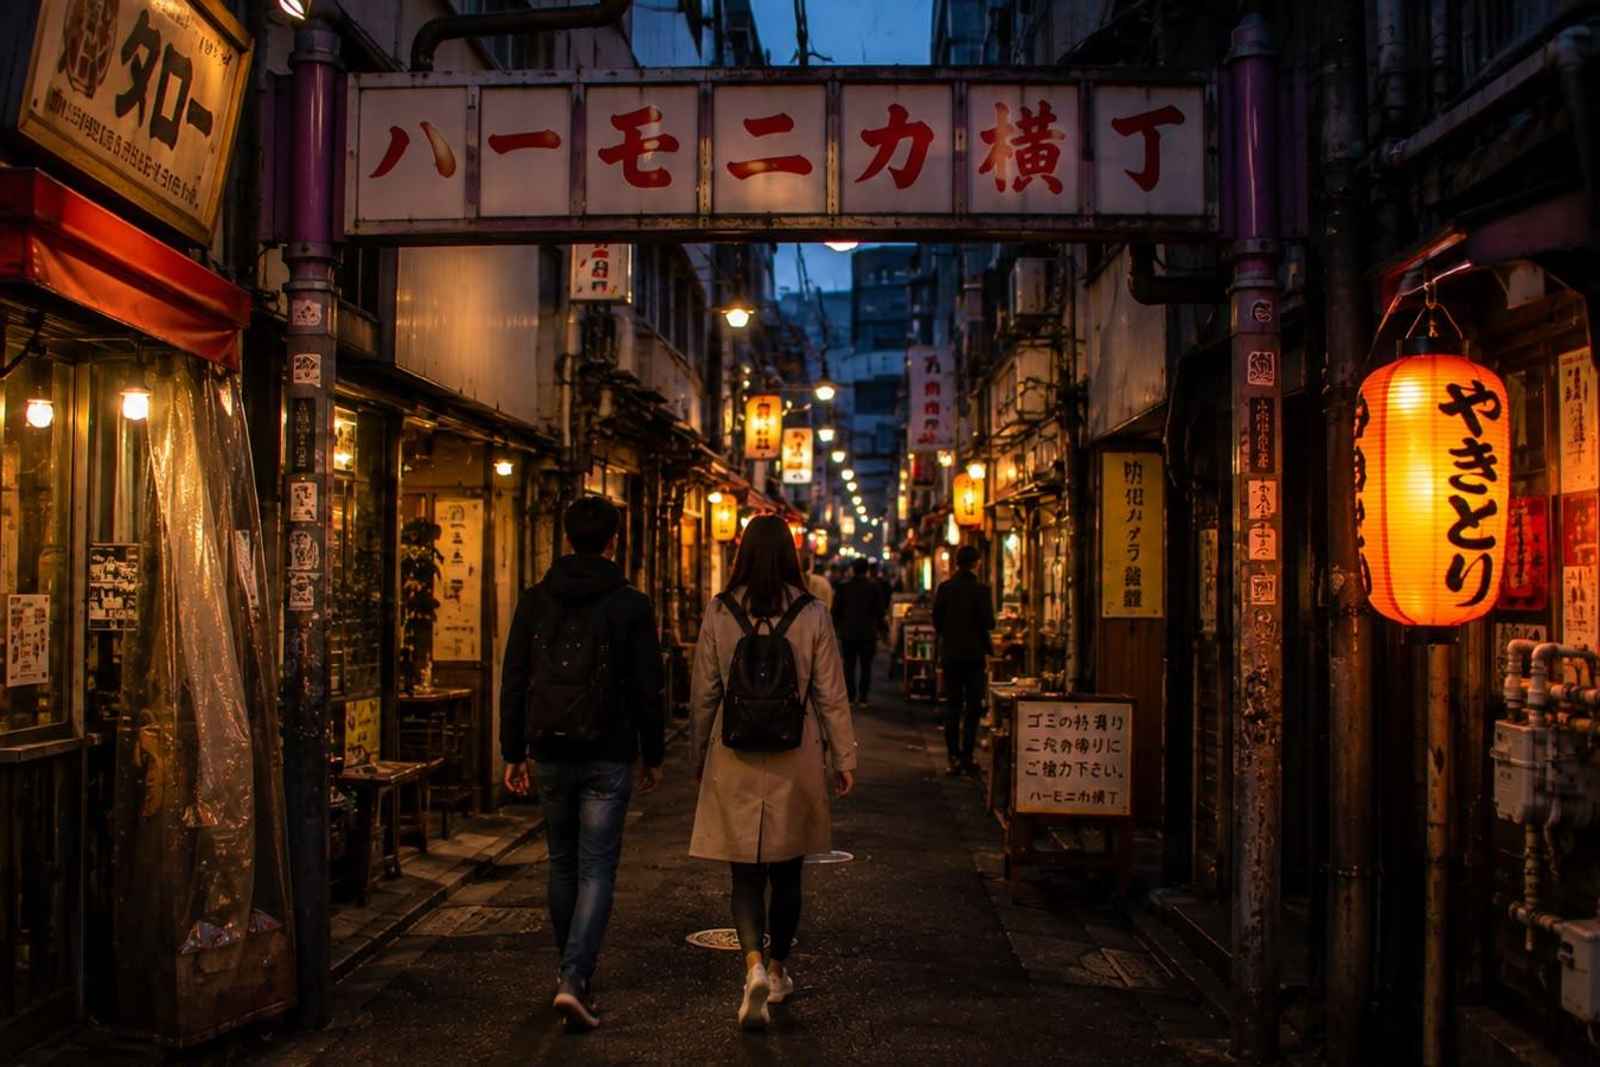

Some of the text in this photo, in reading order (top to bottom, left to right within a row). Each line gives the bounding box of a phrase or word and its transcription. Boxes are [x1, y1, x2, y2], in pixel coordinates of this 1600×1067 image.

[369, 100, 1186, 194] ハーモニカ横丁
[1438, 379, 1502, 608] やきとり
